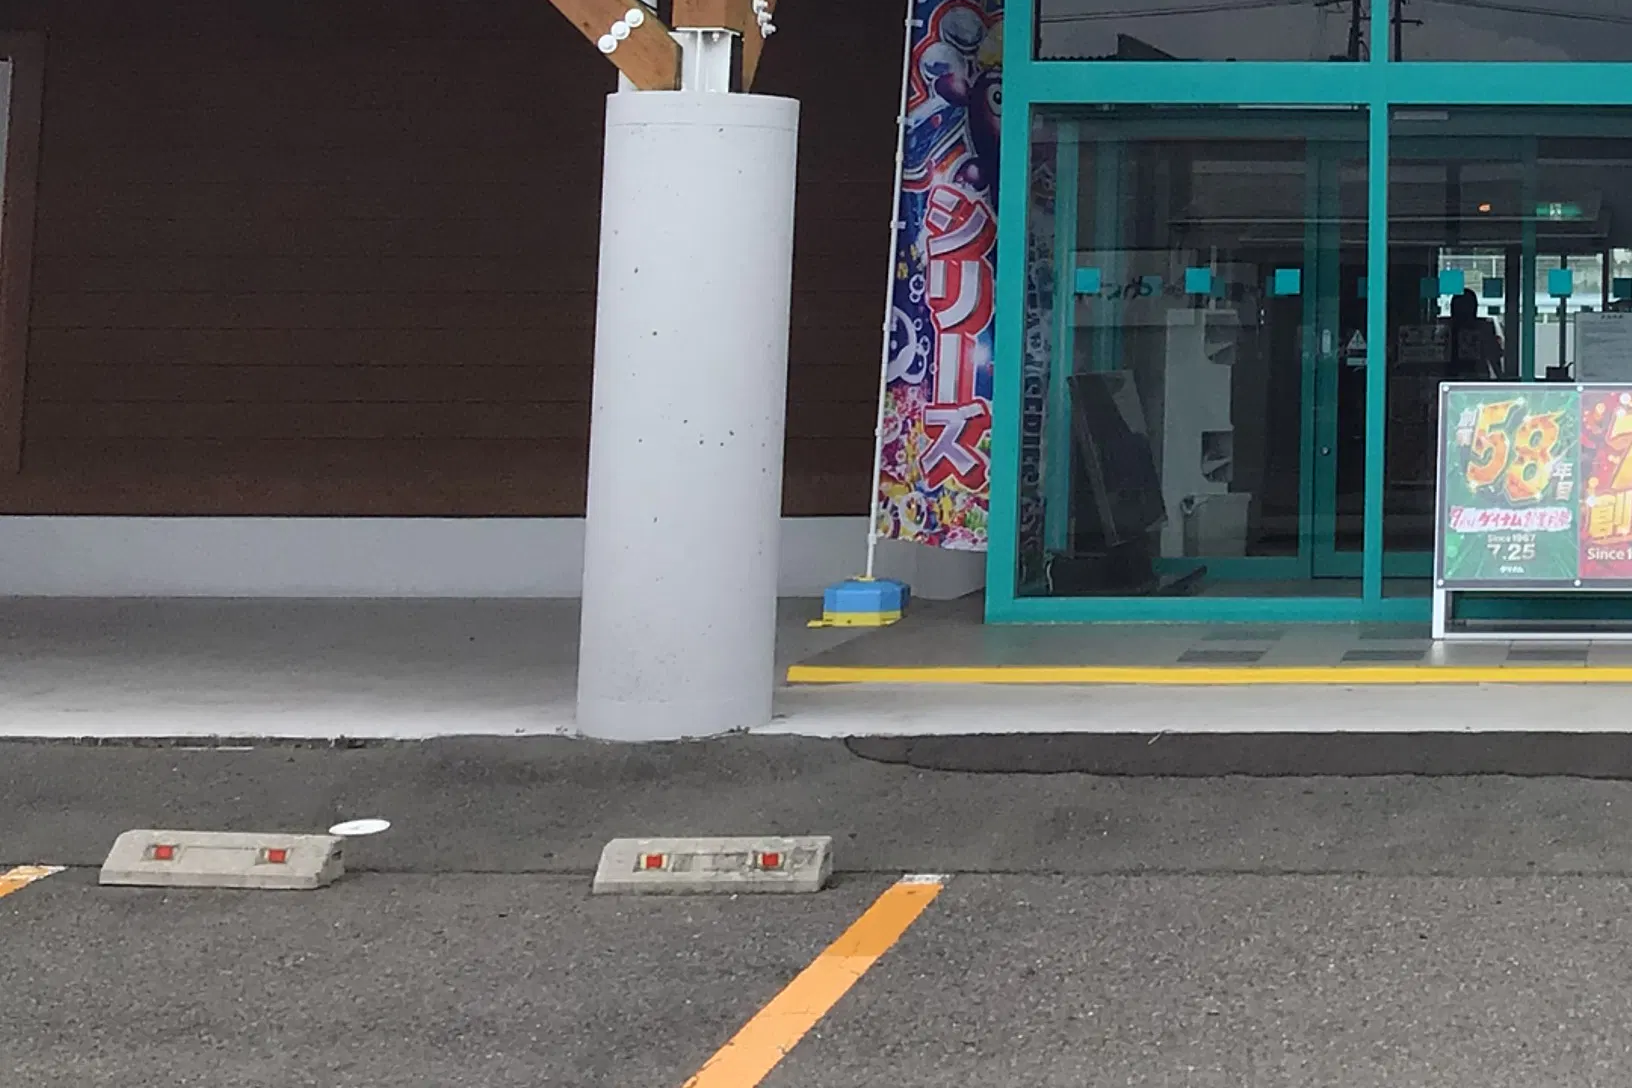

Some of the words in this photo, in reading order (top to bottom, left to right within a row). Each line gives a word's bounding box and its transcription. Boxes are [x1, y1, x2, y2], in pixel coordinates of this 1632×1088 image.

[921, 186, 990, 478] シリーズ
[1466, 399, 1562, 502] 58
[1487, 543, 1536, 561] 7.25
[1587, 547, 1625, 560] Since
